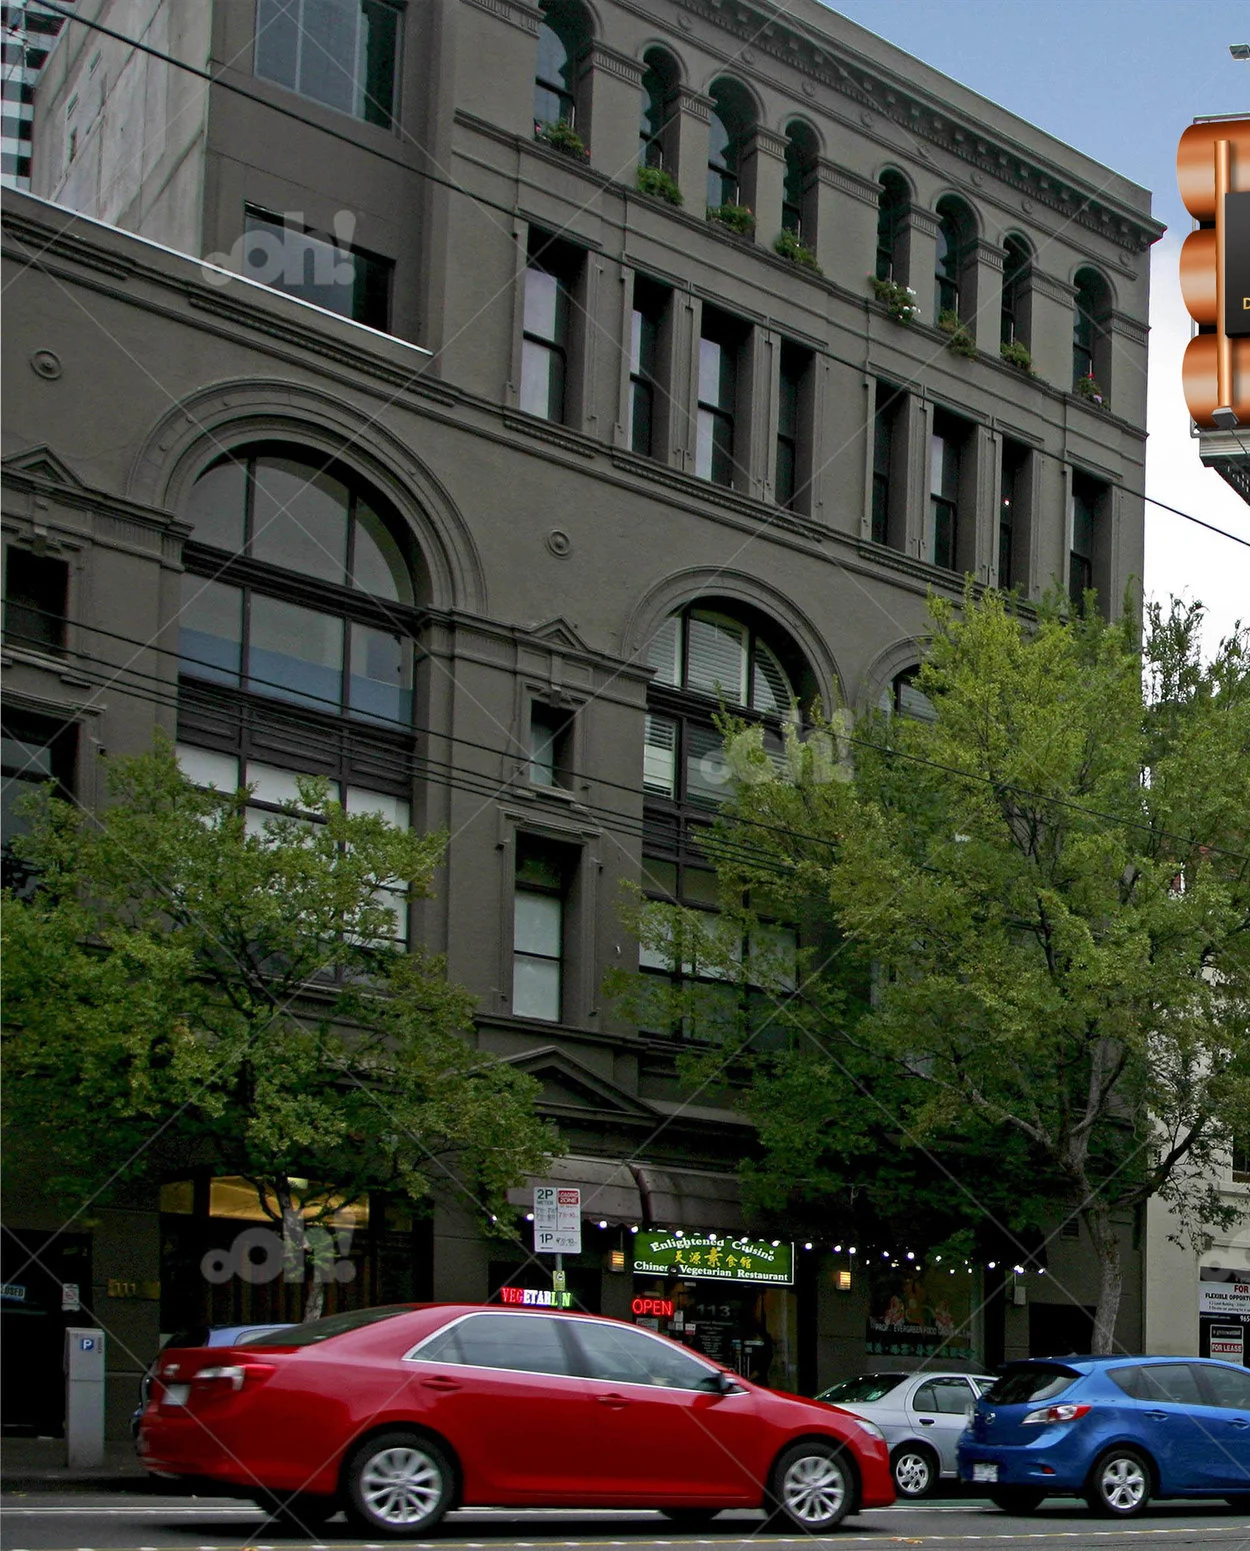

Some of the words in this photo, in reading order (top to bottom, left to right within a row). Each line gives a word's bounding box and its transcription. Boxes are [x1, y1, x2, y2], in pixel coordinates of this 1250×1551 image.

[537, 1189, 554, 1200] 2P
[539, 1233, 554, 1244] 1P
[650, 1237, 725, 1252] Enlightened
[731, 1239, 775, 1262] Cuisine
[633, 1260, 668, 1272] Chine
[680, 1264, 732, 1277] Vegetarian
[737, 1269, 789, 1282] Restaurant
[1234, 1284, 1249, 1294] FOR
[631, 1299, 674, 1316] OPEN
[83, 1339, 92, 1350] P
[1212, 1344, 1223, 1352] FOR
[1224, 1344, 1242, 1352] LEASE
